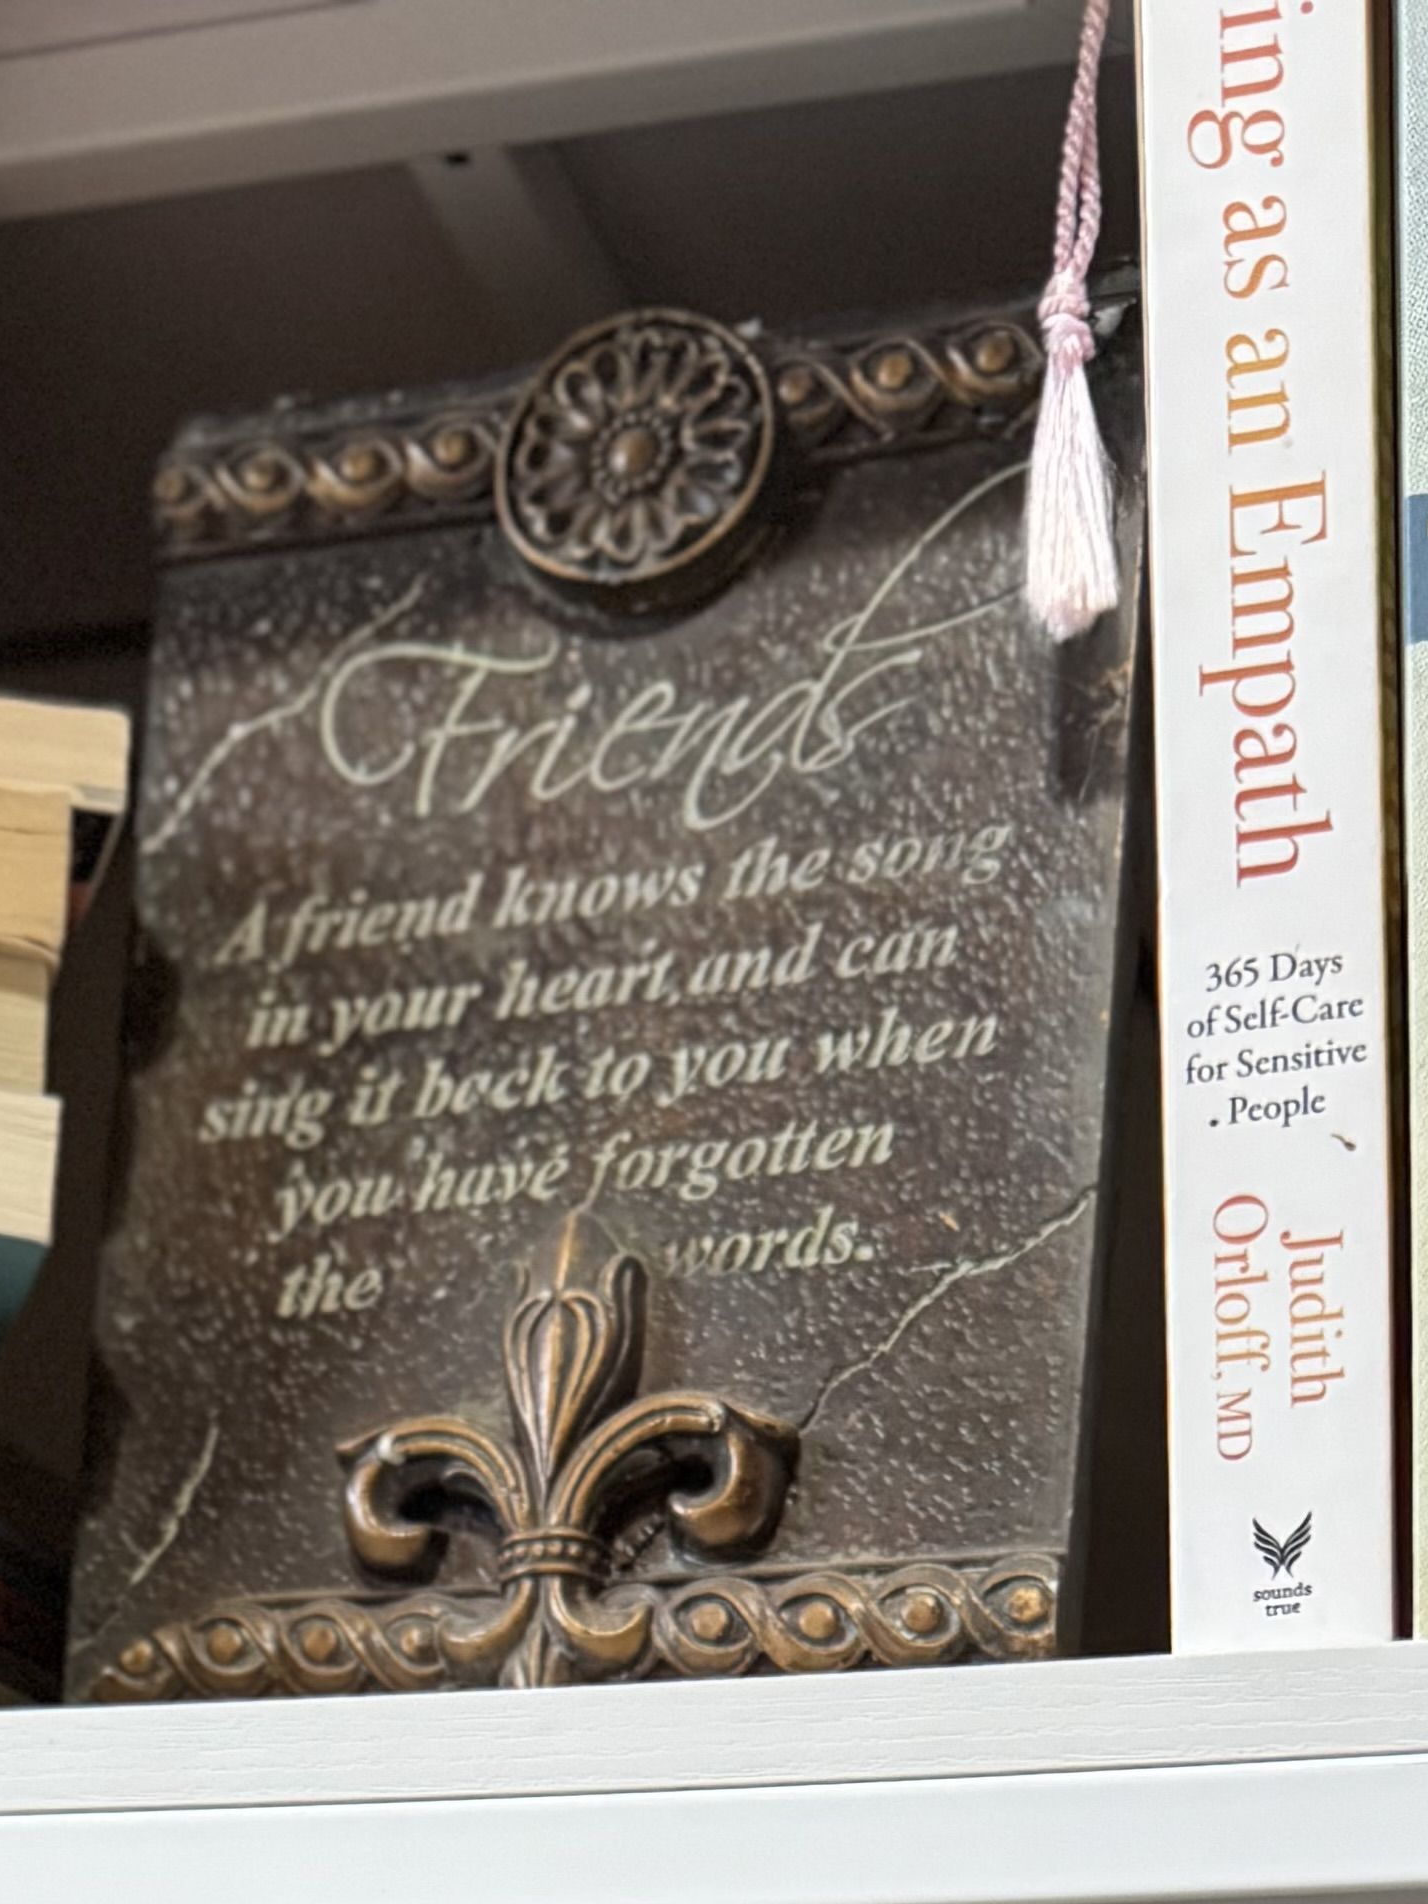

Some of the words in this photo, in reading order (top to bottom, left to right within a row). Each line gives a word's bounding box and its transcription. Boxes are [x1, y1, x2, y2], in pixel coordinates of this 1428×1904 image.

[1222, 195, 1289, 300] as
[1225, 328, 1290, 457] an
[1198, 470, 1333, 890] Empath
[213, 901, 269, 965] A
[281, 876, 482, 962] friend
[496, 865, 702, 928] knows
[724, 835, 827, 899] the
[847, 822, 1013, 886] song
[246, 999, 310, 1049] in
[319, 980, 482, 1056] your
[689, 923, 819, 992] and
[836, 921, 960, 980] can
[1187, 1004, 1221, 1038] of
[1224, 994, 1364, 1034] Self-Care
[1205, 955, 1259, 993] 365
[1269, 953, 1343, 986] Days
[197, 1080, 332, 1150] sing
[348, 1070, 401, 1127] it
[414, 1045, 567, 1118] back
[583, 1057, 650, 1104] to
[657, 1034, 791, 1106] you
[815, 1006, 998, 1073] when
[1186, 1052, 1228, 1085] for
[1236, 1039, 1368, 1078] Sensitive
[1228, 1085, 1327, 1128] People
[269, 1168, 404, 1242] you
[422, 1140, 568, 1210] have
[584, 1120, 896, 1215] forgotten
[276, 1259, 383, 1320] the
[664, 1204, 876, 1280] words.
[1211, 1193, 1273, 1383] Orloff,
[1281, 1225, 1347, 1409] Judith
[1216, 1389, 1254, 1463] MD
[1252, 1582, 1313, 1603] sounds
[1265, 1601, 1301, 1617] true
